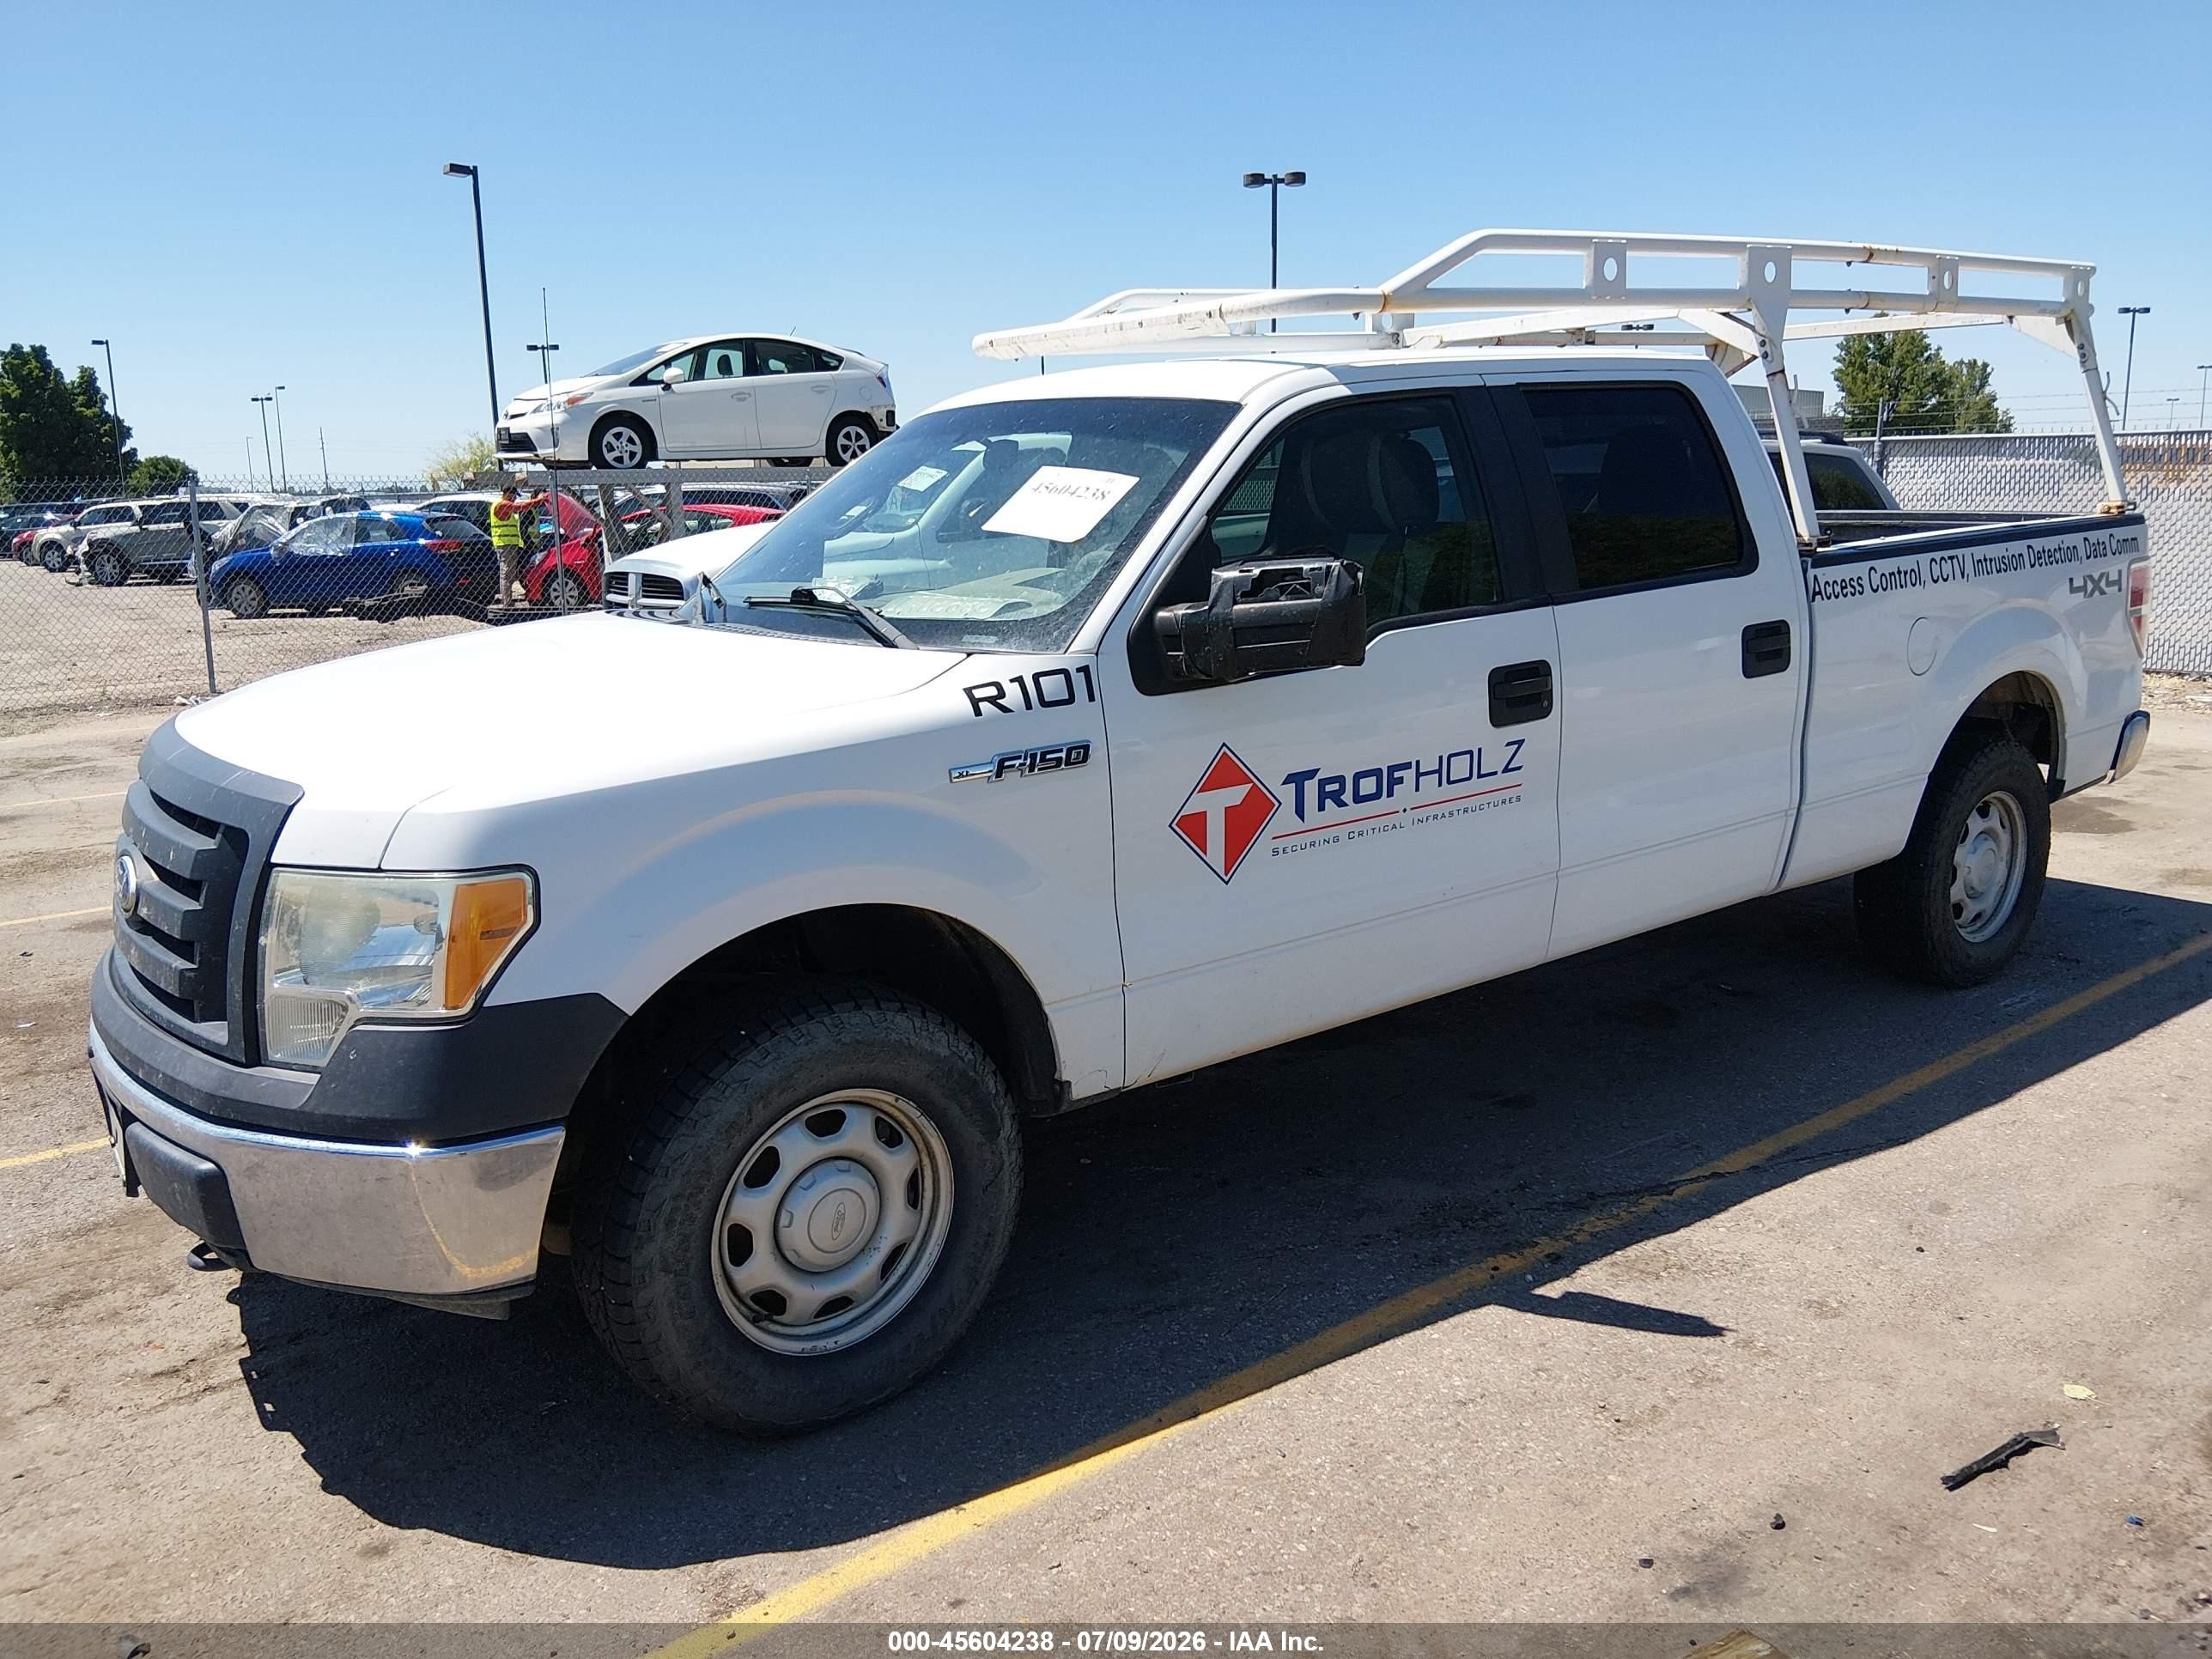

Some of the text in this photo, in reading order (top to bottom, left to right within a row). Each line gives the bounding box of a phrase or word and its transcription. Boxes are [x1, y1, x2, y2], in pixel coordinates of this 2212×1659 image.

[1811, 533, 2140, 603] Access Control, CCTV, Intrusion Detection, Data Comm
[2069, 569, 2123, 599] 4X4
[962, 664, 1096, 717] R101
[988, 739, 1092, 783] F-150
